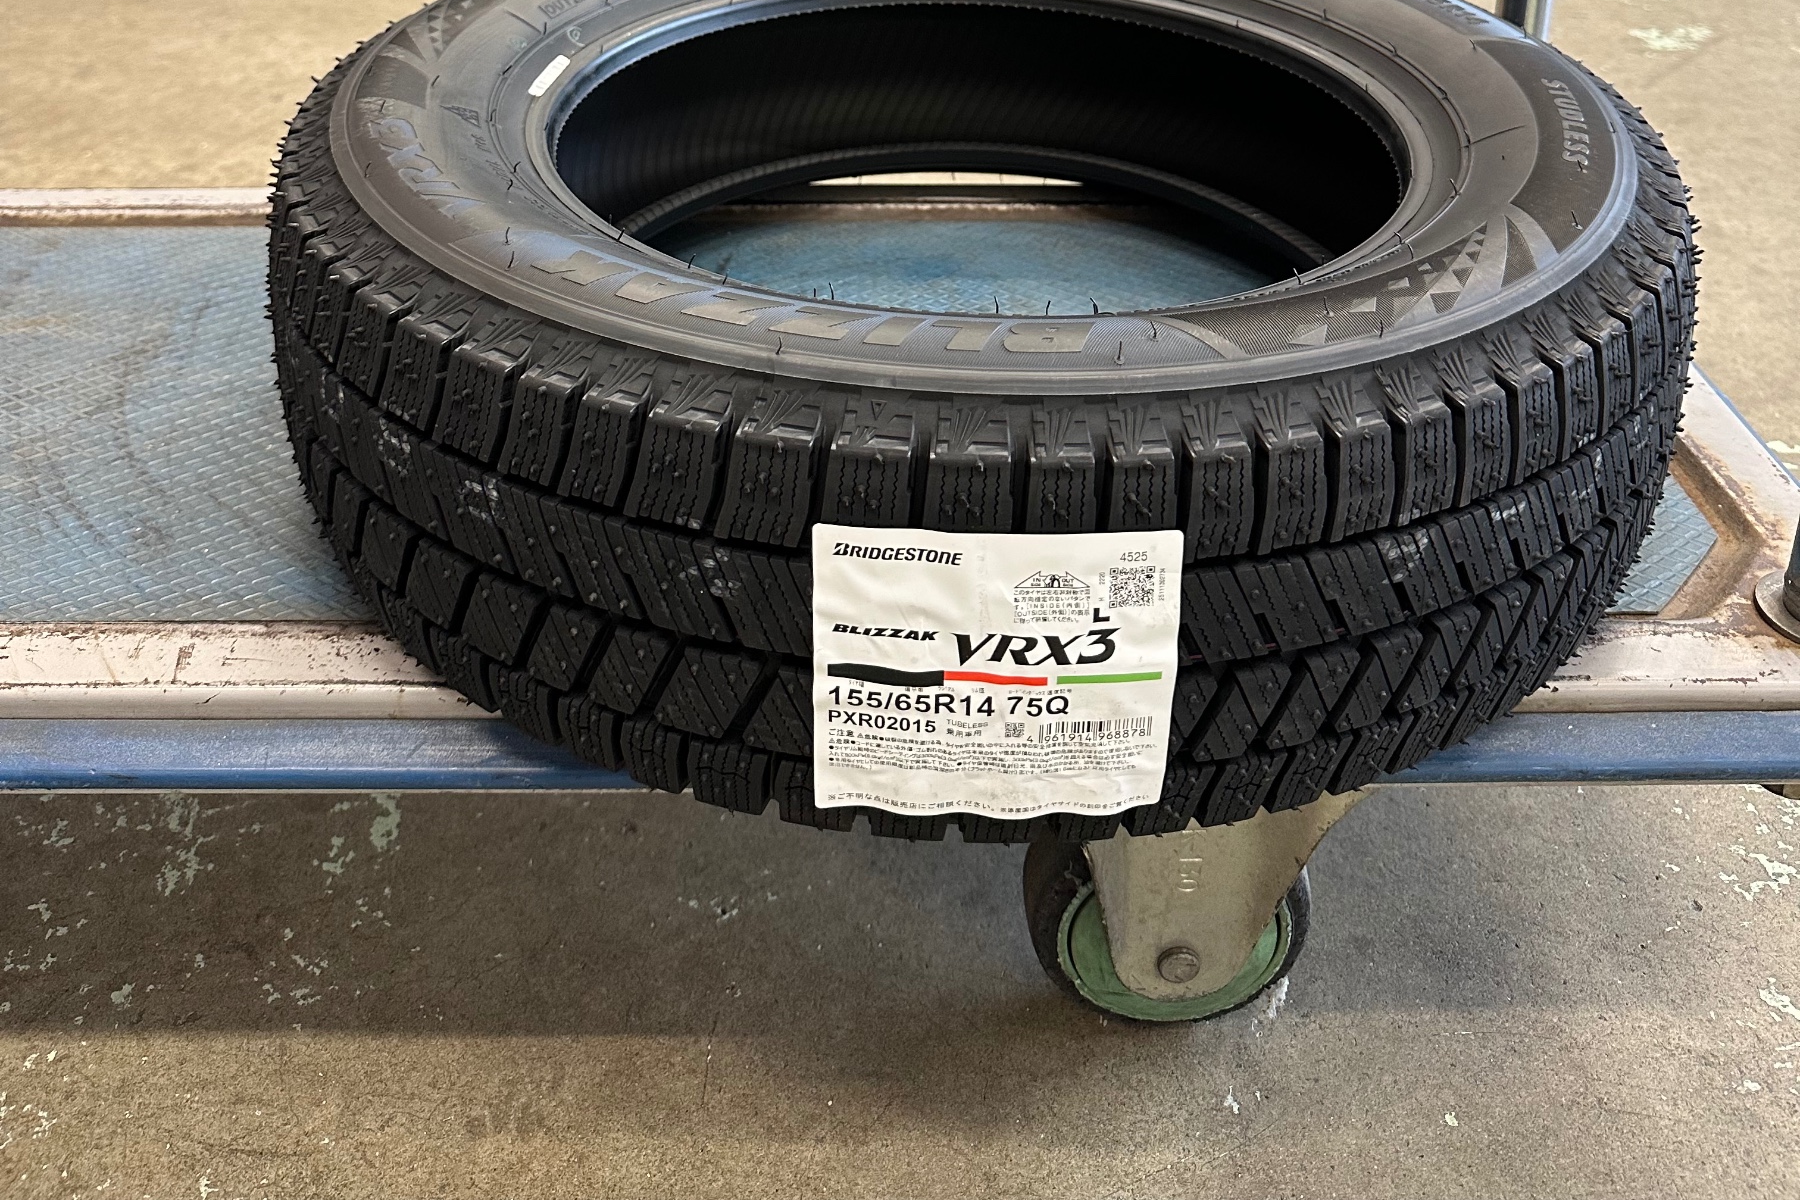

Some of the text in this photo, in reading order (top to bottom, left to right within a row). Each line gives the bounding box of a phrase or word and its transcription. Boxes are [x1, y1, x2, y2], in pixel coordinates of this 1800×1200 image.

[1541, 77, 1590, 166] STUDLESS
[529, 248, 1097, 353] BLIZZAK
[832, 542, 963, 565] BRIDGESTONE
[1119, 551, 1149, 562] 4525
[832, 623, 1122, 667] BLIZZAK VRX3
[828, 685, 1070, 718] 155/65R14 75Q
[828, 709, 937, 733] PXR02015
[946, 718, 989, 729] TUBELESS
